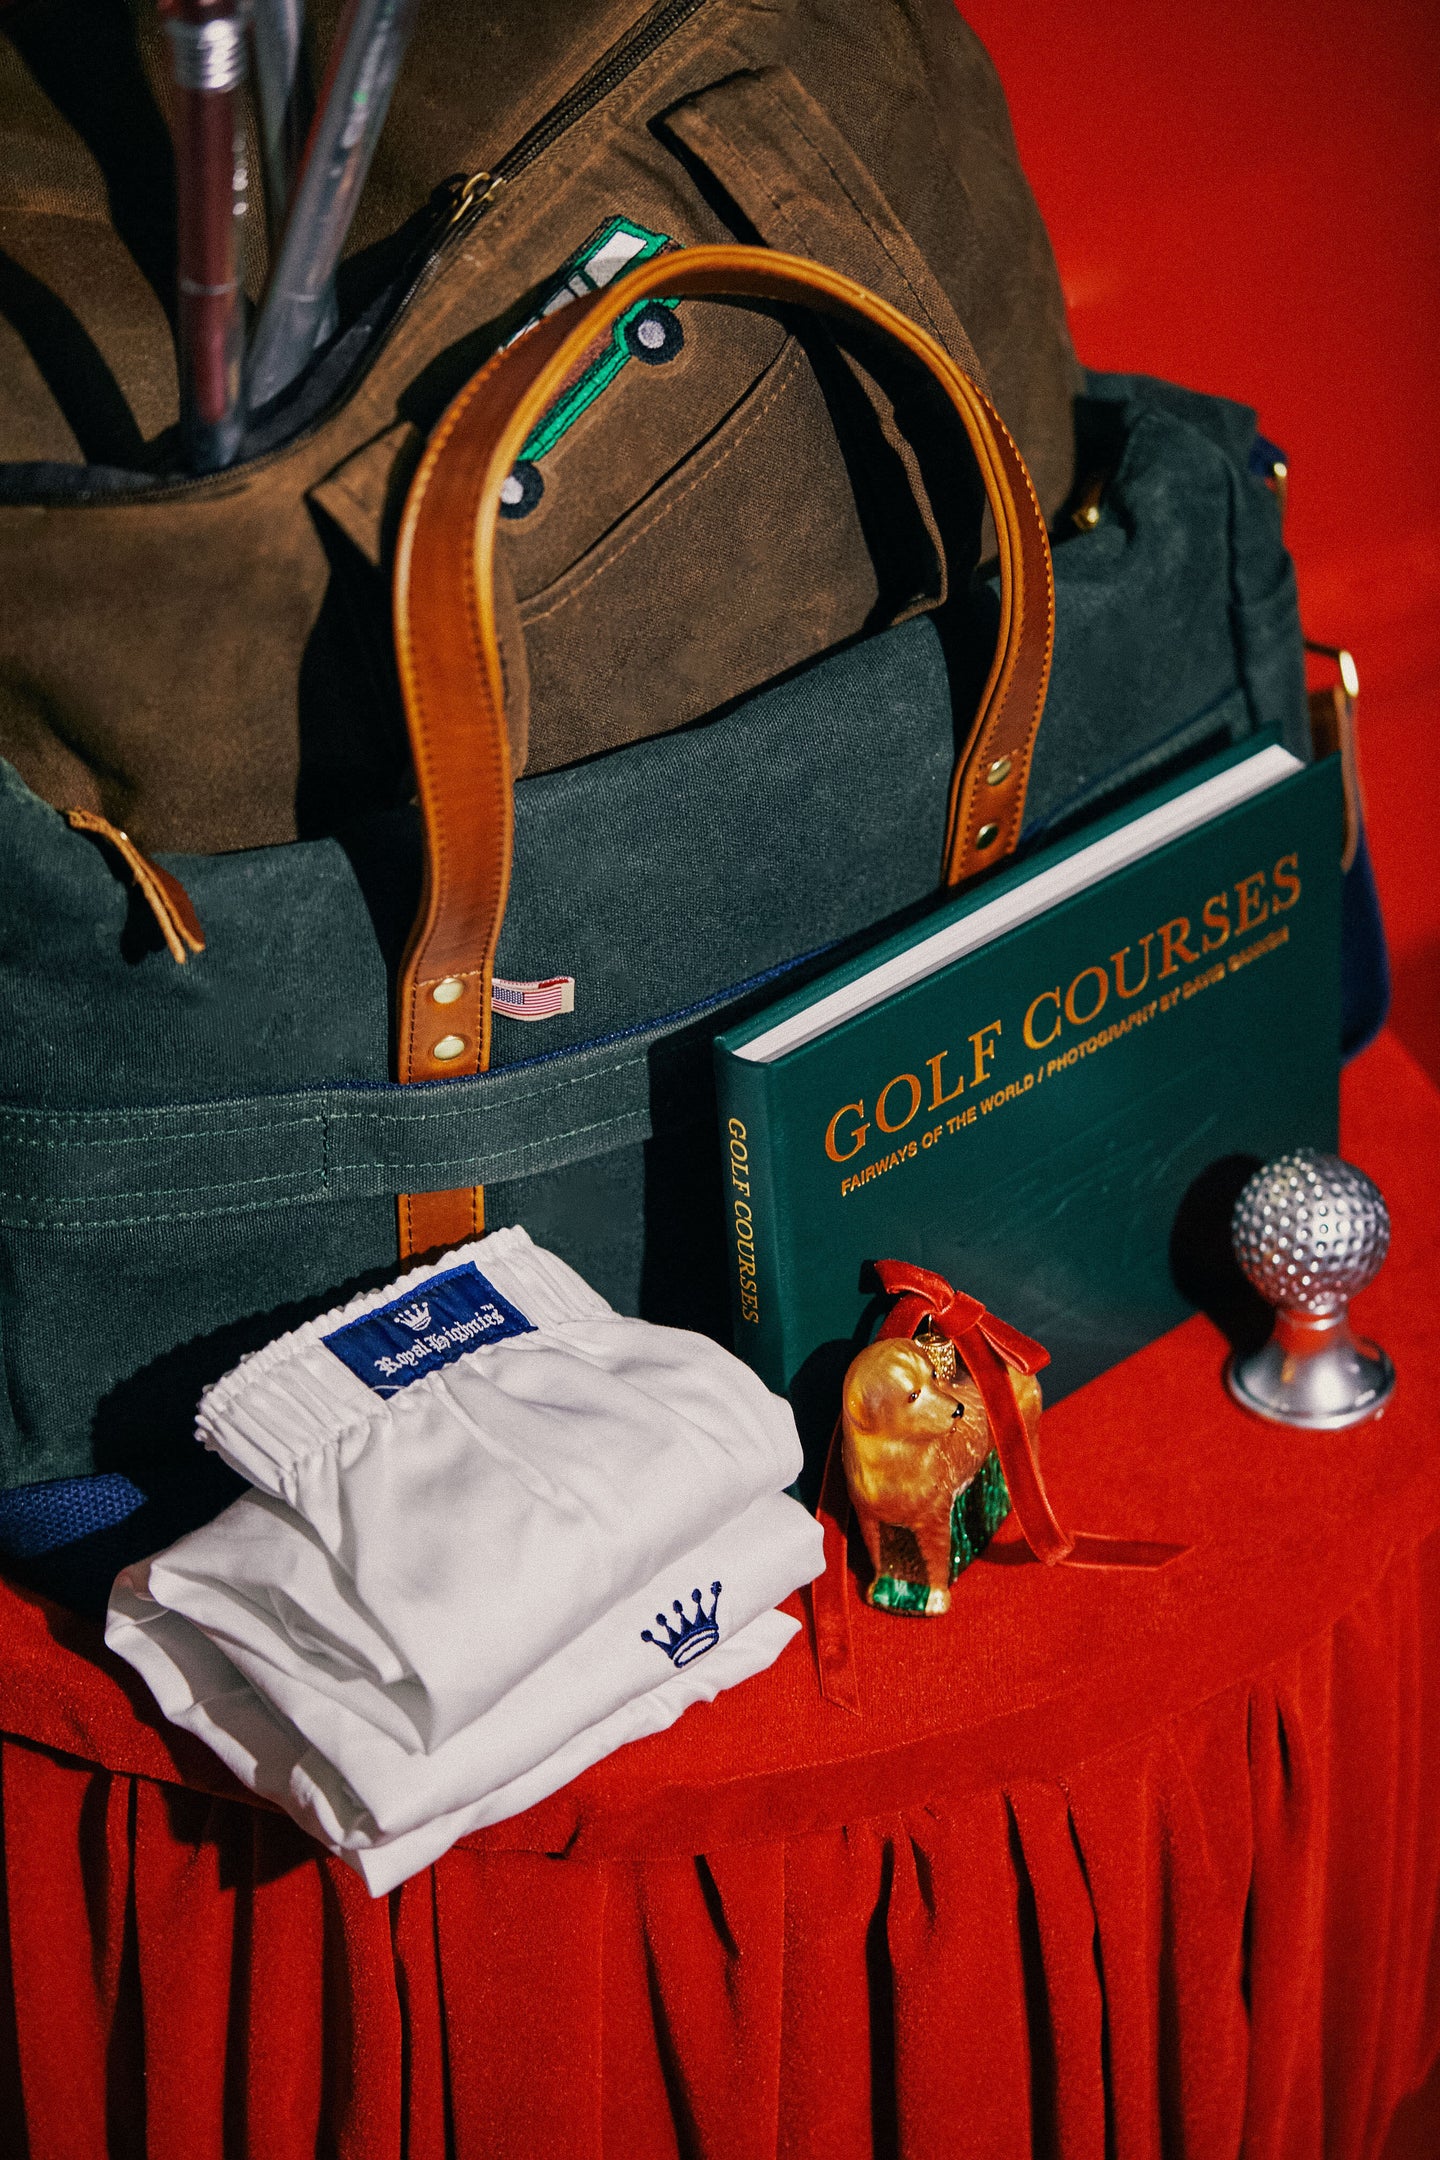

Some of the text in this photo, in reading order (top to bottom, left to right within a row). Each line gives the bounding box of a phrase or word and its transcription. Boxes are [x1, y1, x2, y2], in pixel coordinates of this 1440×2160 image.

[824, 852, 1301, 1162] GOLF COURSES
[840, 1140, 918, 1198] FAIRWAYS
[921, 1124, 943, 1149] OF
[945, 1105, 978, 1135] THE
[979, 1073, 1035, 1116] WORLD
[1046, 1000, 1158, 1078] PHOTOGRAPHY
[1159, 986, 1181, 1012] BY
[728, 1117, 759, 1324] GOLF COURSES
[374, 1338, 432, 1378] Royal
